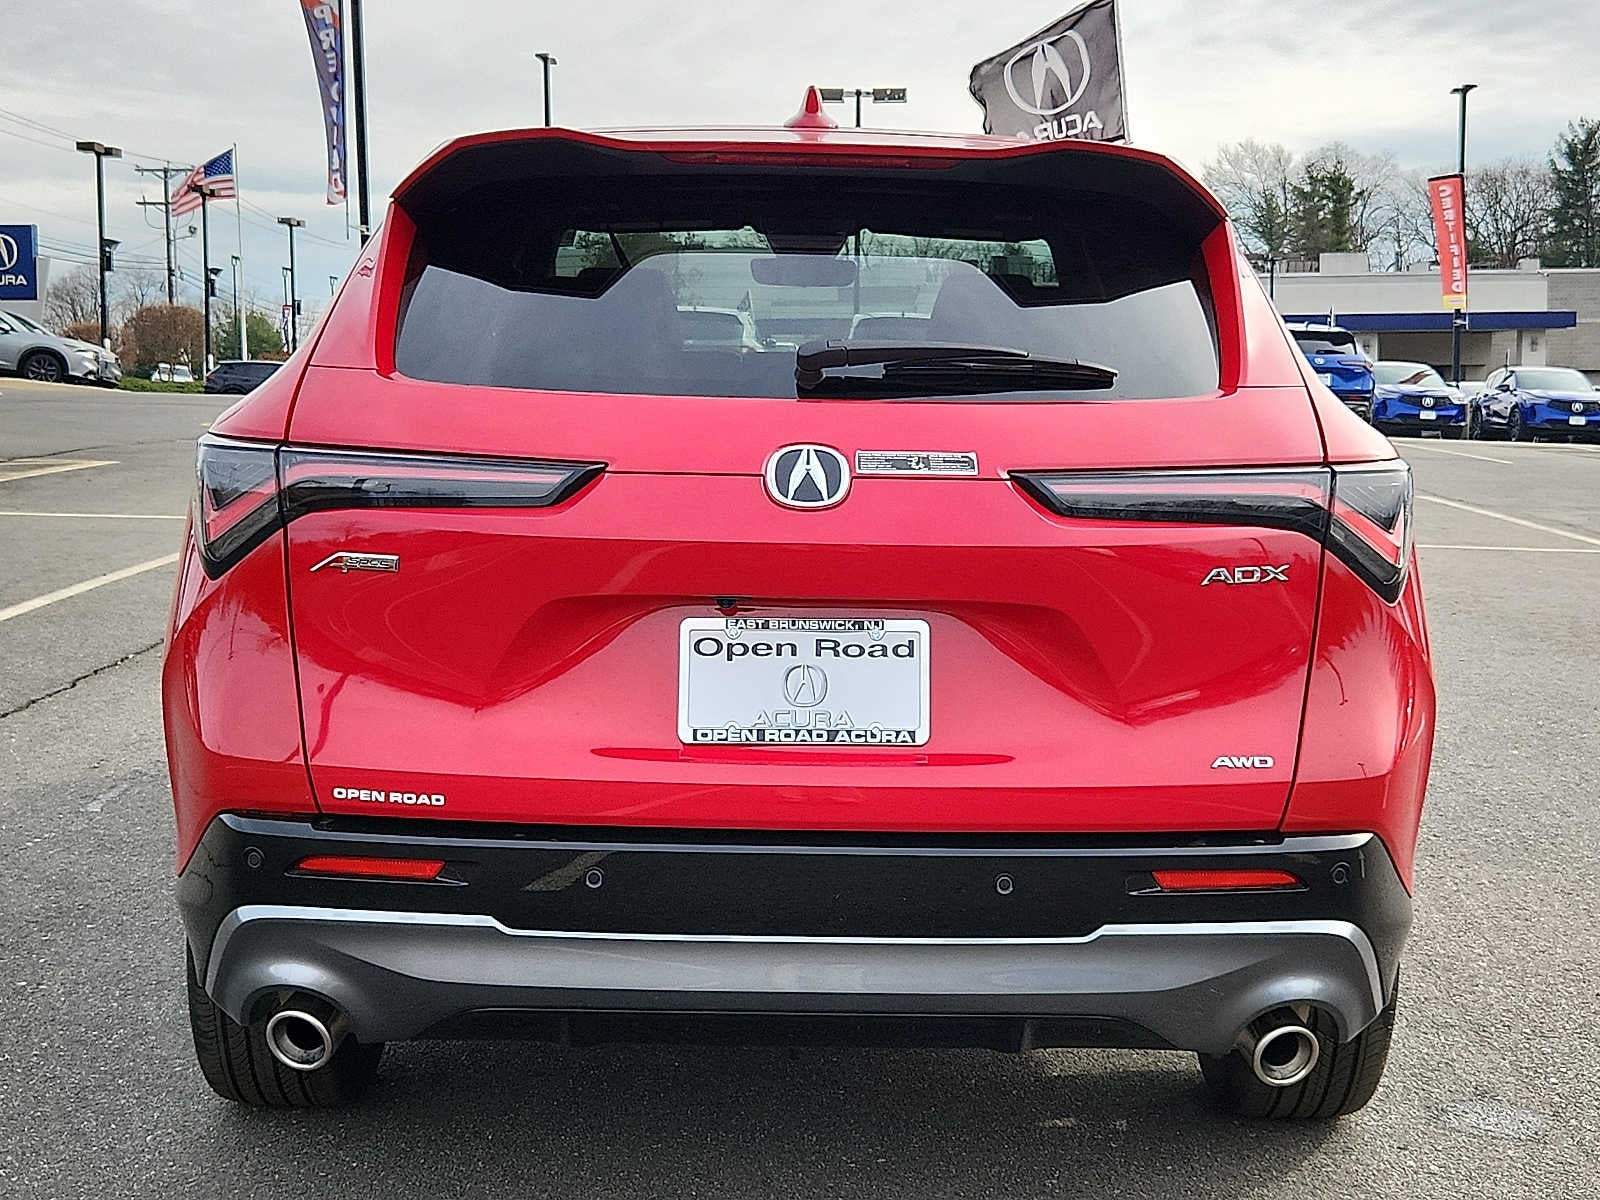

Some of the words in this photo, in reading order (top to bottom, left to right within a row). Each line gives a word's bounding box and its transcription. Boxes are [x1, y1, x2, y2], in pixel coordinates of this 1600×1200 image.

[1201, 564, 1290, 586] ADX
[727, 619, 765, 630] EAST
[769, 619, 859, 631] BRUNSWICK,
[864, 620, 883, 630] NJ
[693, 637, 797, 661] Open
[815, 638, 915, 658] Road
[752, 709, 855, 728] ACURA
[696, 729, 758, 742] OPEN
[765, 730, 828, 742] ROAD
[834, 730, 912, 743] ACURA
[1211, 756, 1274, 768] AWD
[333, 787, 385, 802] OPEN
[389, 792, 445, 806] ROAD
